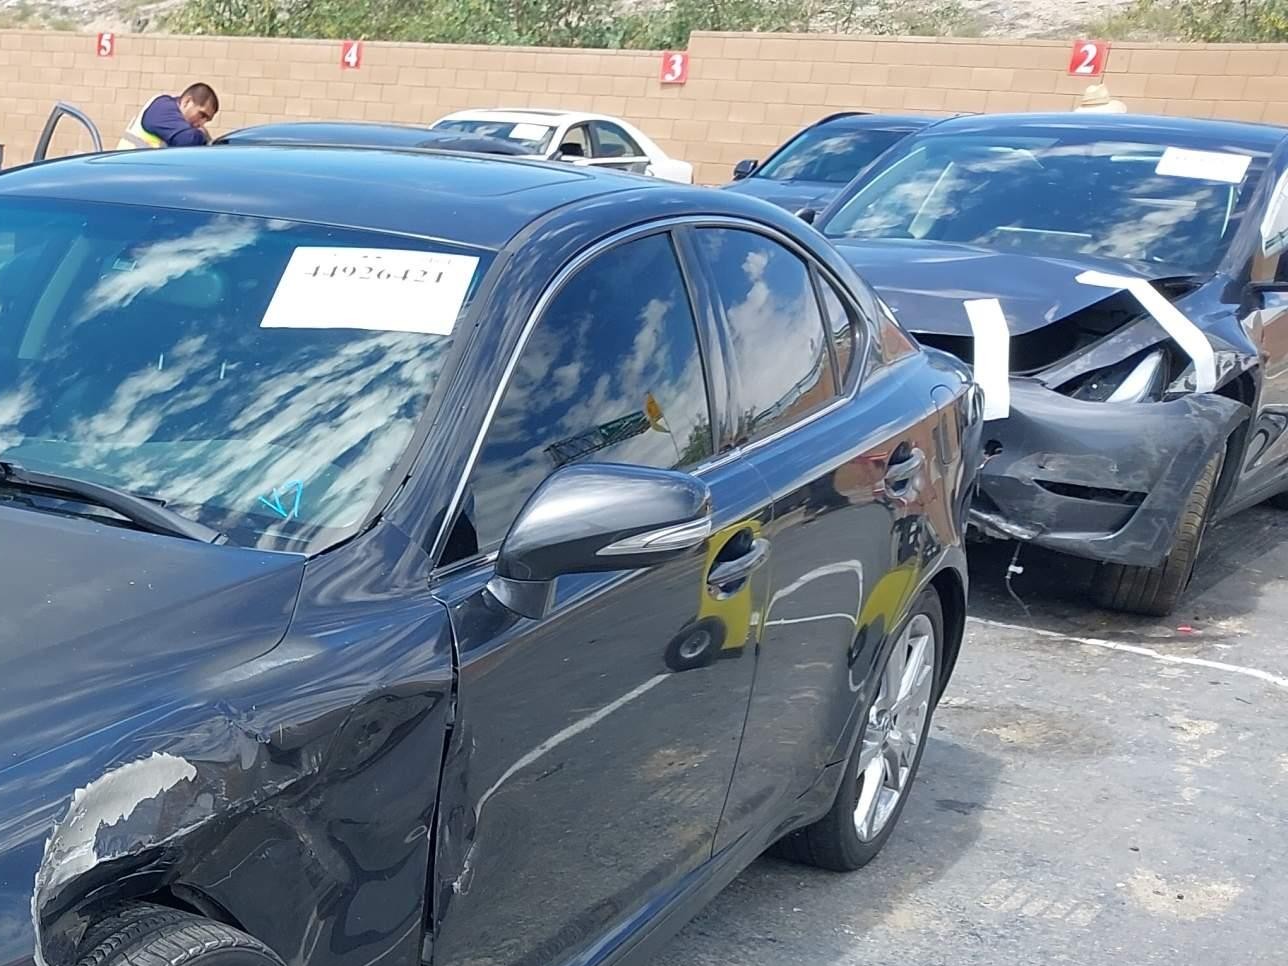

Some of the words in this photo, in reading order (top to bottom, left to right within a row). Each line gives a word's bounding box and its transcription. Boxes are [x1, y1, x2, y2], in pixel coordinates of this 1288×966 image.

[99, 33, 112, 56] 5
[344, 42, 358, 67] 4
[664, 54, 684, 81] 3
[1074, 44, 1097, 74] 2
[305, 264, 444, 283] 44926421
